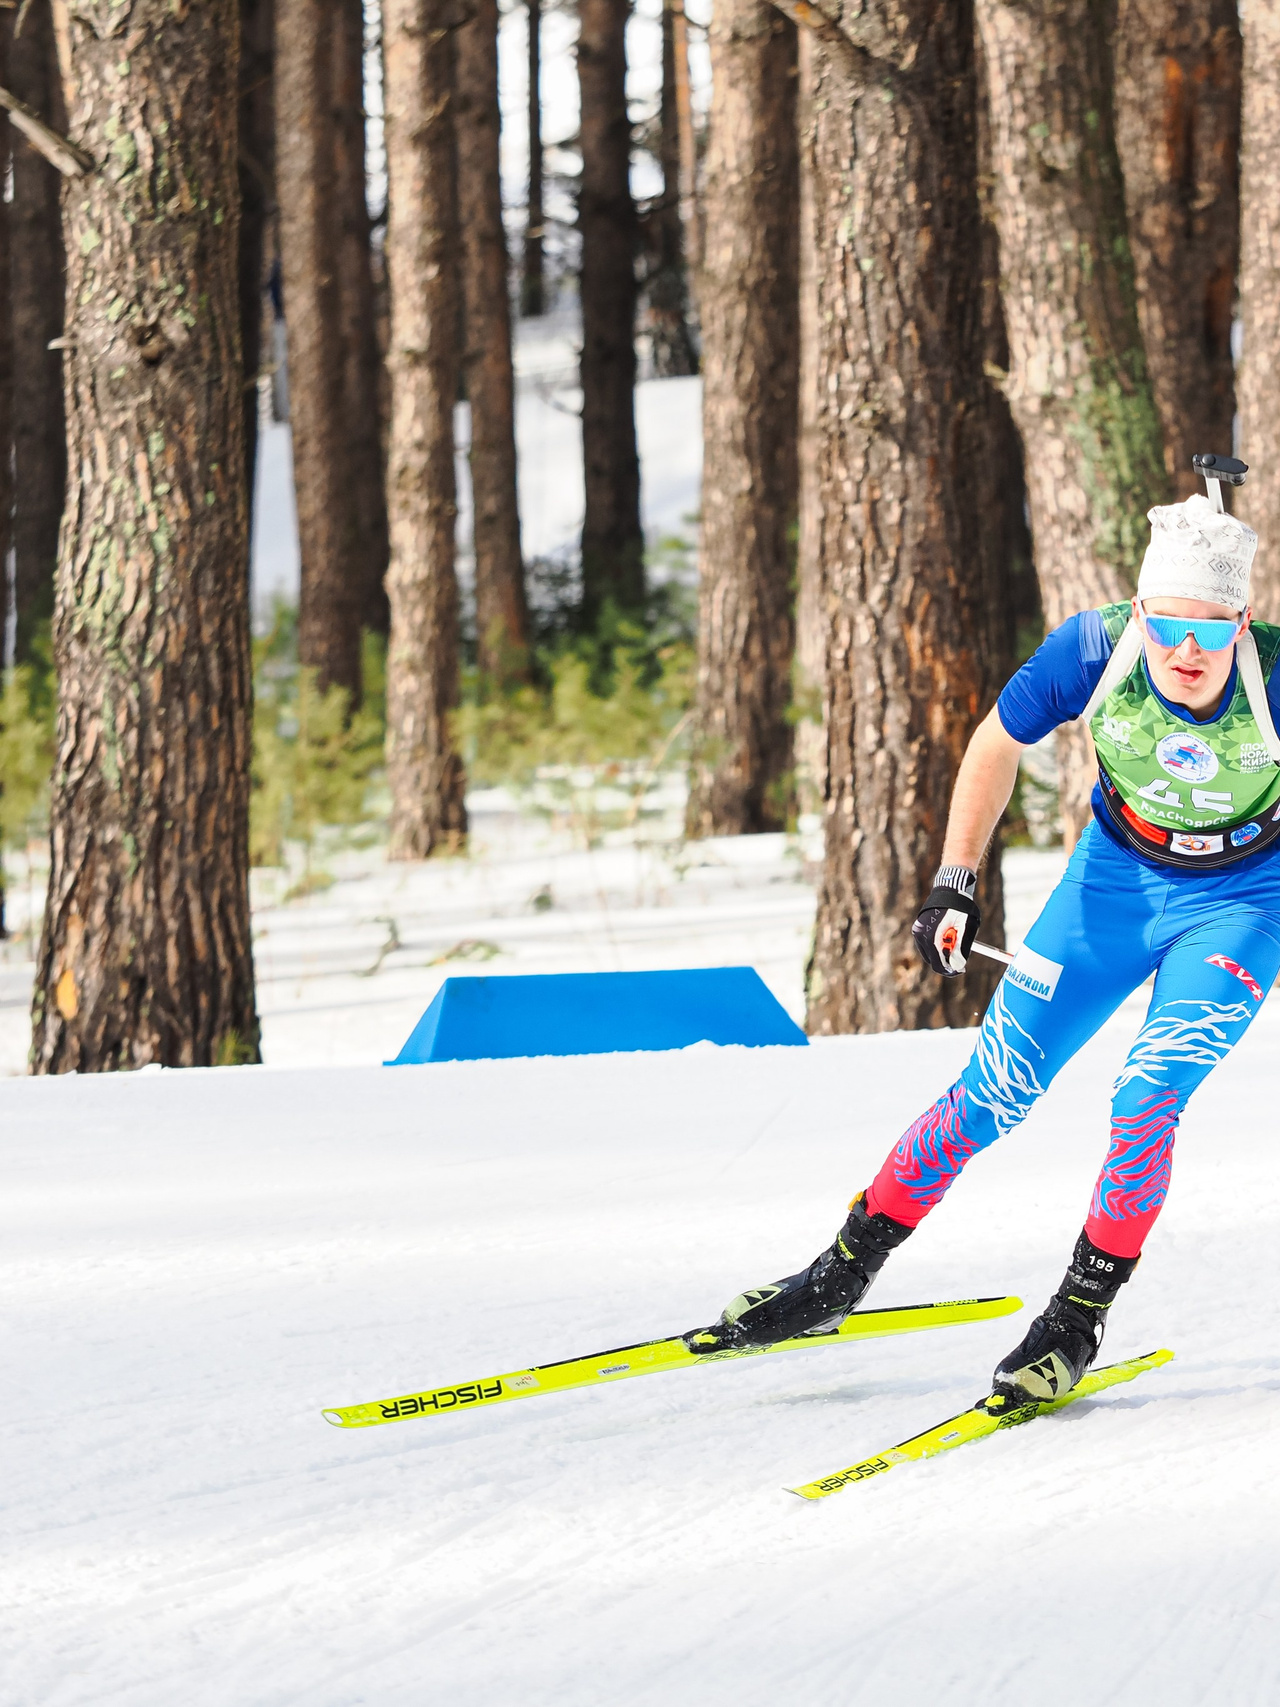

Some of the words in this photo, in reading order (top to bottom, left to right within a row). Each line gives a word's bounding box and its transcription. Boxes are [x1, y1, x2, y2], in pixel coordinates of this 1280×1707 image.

[1240, 743, 1265, 751] СПОР
[1240, 750, 1270, 759] НОРМ
[1136, 778, 1235, 814] 45
[1140, 800, 1231, 828] КРАСНОЯРСК
[1008, 966, 1050, 996] GAZPROM
[1205, 954, 1262, 999] KV+
[1089, 1255, 1115, 1273] 195
[694, 1344, 772, 1364] FISCHER
[379, 1380, 502, 1419] FISCHER
[996, 1403, 1038, 1430] FISCHER
[813, 1458, 889, 1492] FISCHER
